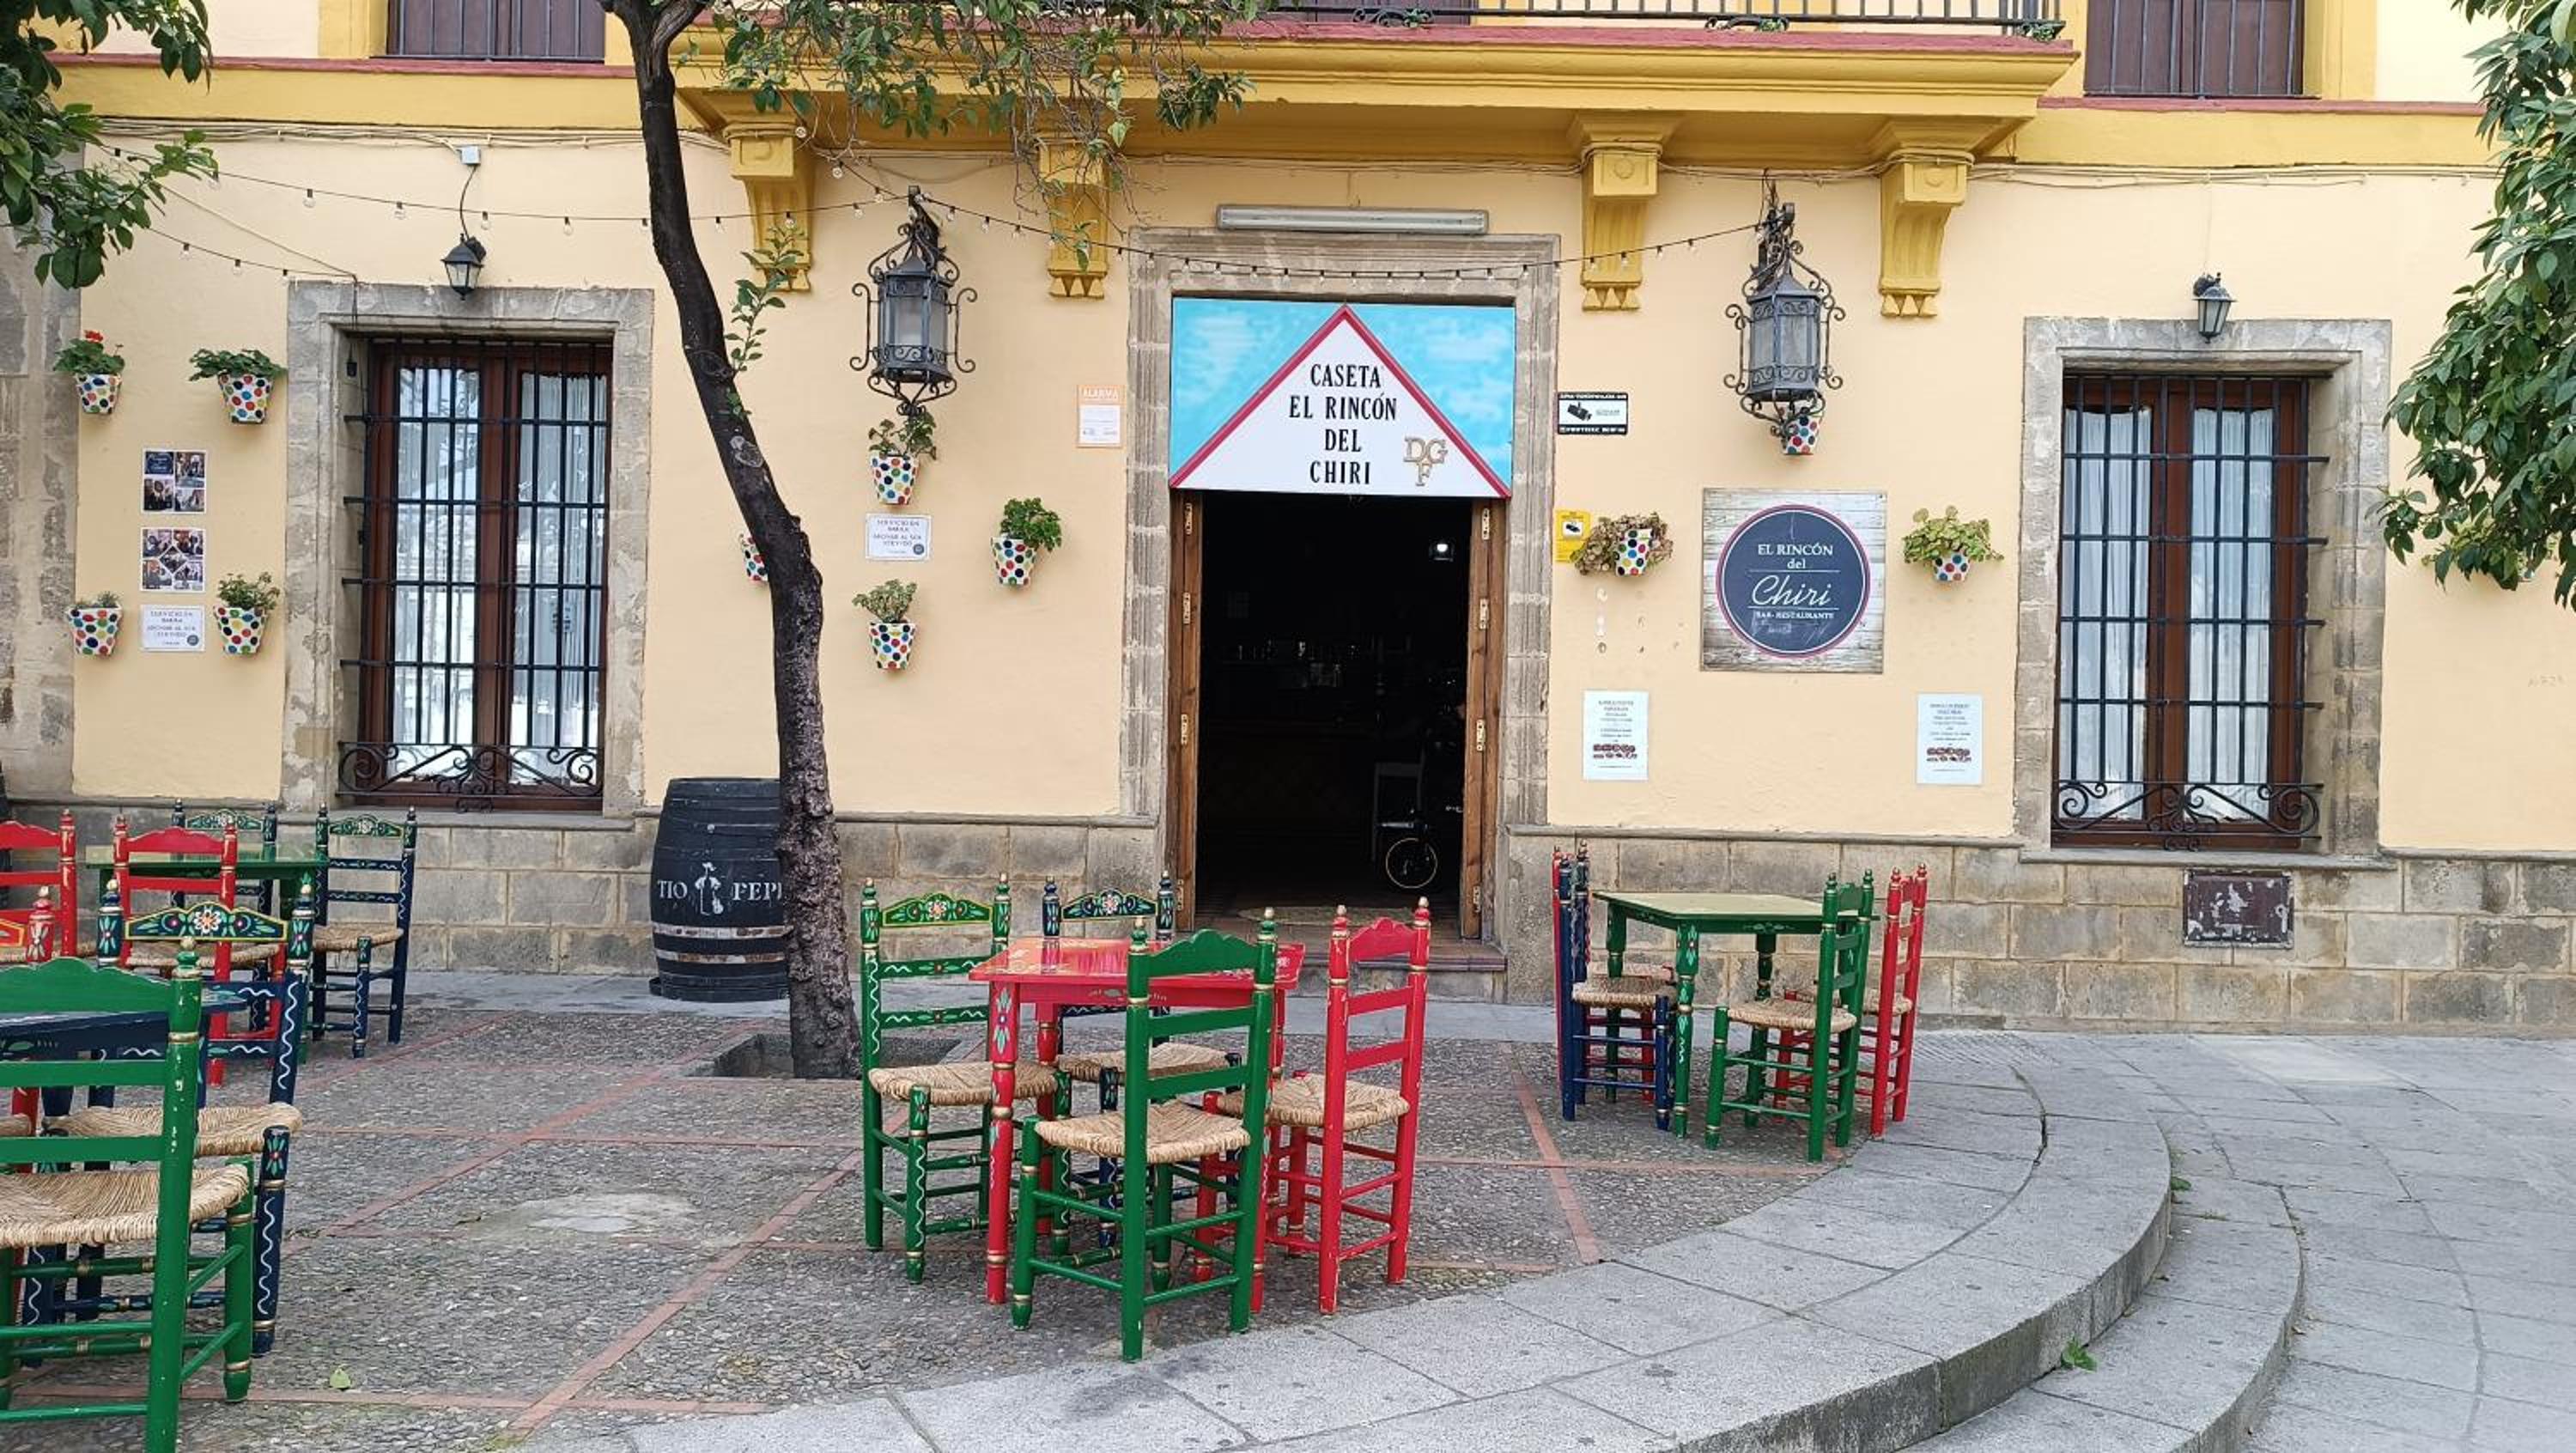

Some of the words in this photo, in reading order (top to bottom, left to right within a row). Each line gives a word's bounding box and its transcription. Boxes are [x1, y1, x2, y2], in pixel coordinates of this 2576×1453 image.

[1309, 363, 1382, 388] CASETA
[1289, 395, 1313, 419] EL
[1325, 392, 1397, 421] RINCÓN
[1324, 429, 1362, 453] DEL
[1309, 459, 1370, 485] CHIRI
[1757, 544, 1774, 556] EL
[1776, 542, 1833, 556] RINCÓN
[1787, 557, 1806, 569] del
[1752, 575, 1832, 606] Chiri
[657, 880, 688, 900] TIO
